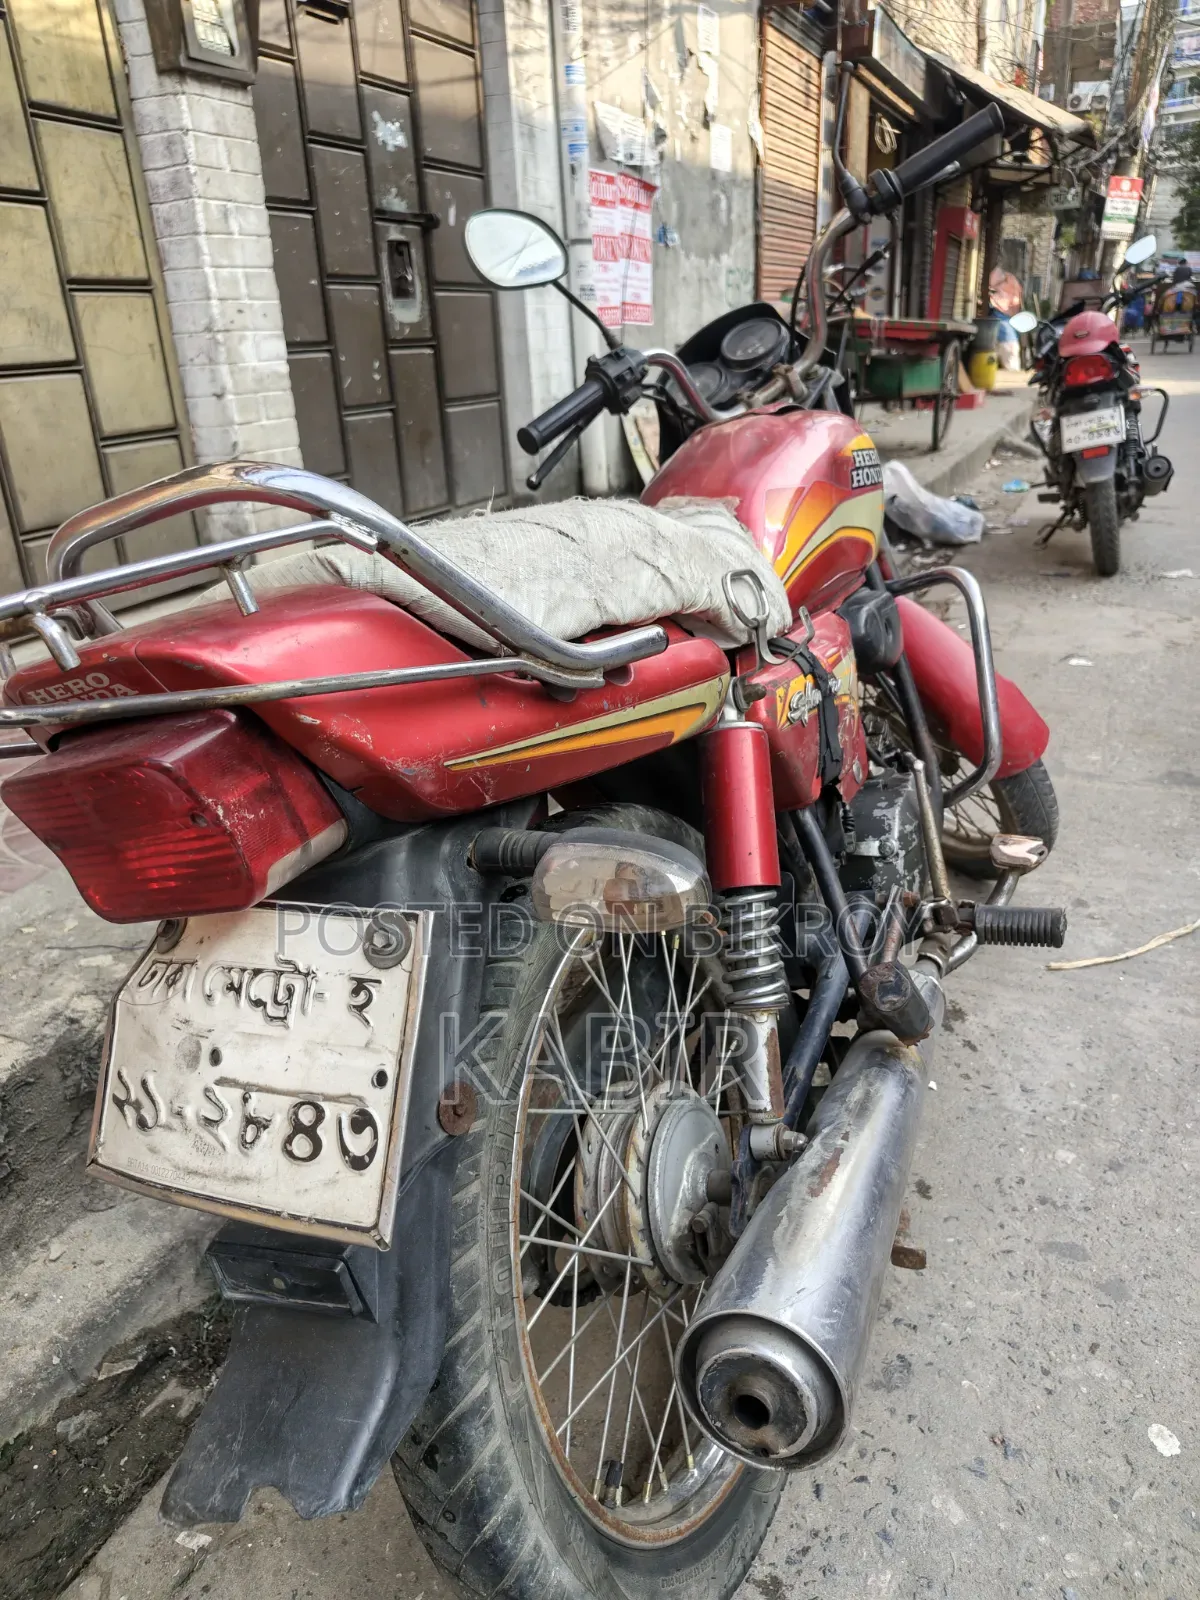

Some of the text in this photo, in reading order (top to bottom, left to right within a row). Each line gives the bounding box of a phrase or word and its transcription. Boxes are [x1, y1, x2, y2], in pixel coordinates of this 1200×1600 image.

[851, 466, 883, 489] HOND
[27, 672, 110, 704] HERO
[137, 957, 198, 1002] ঢাকা
